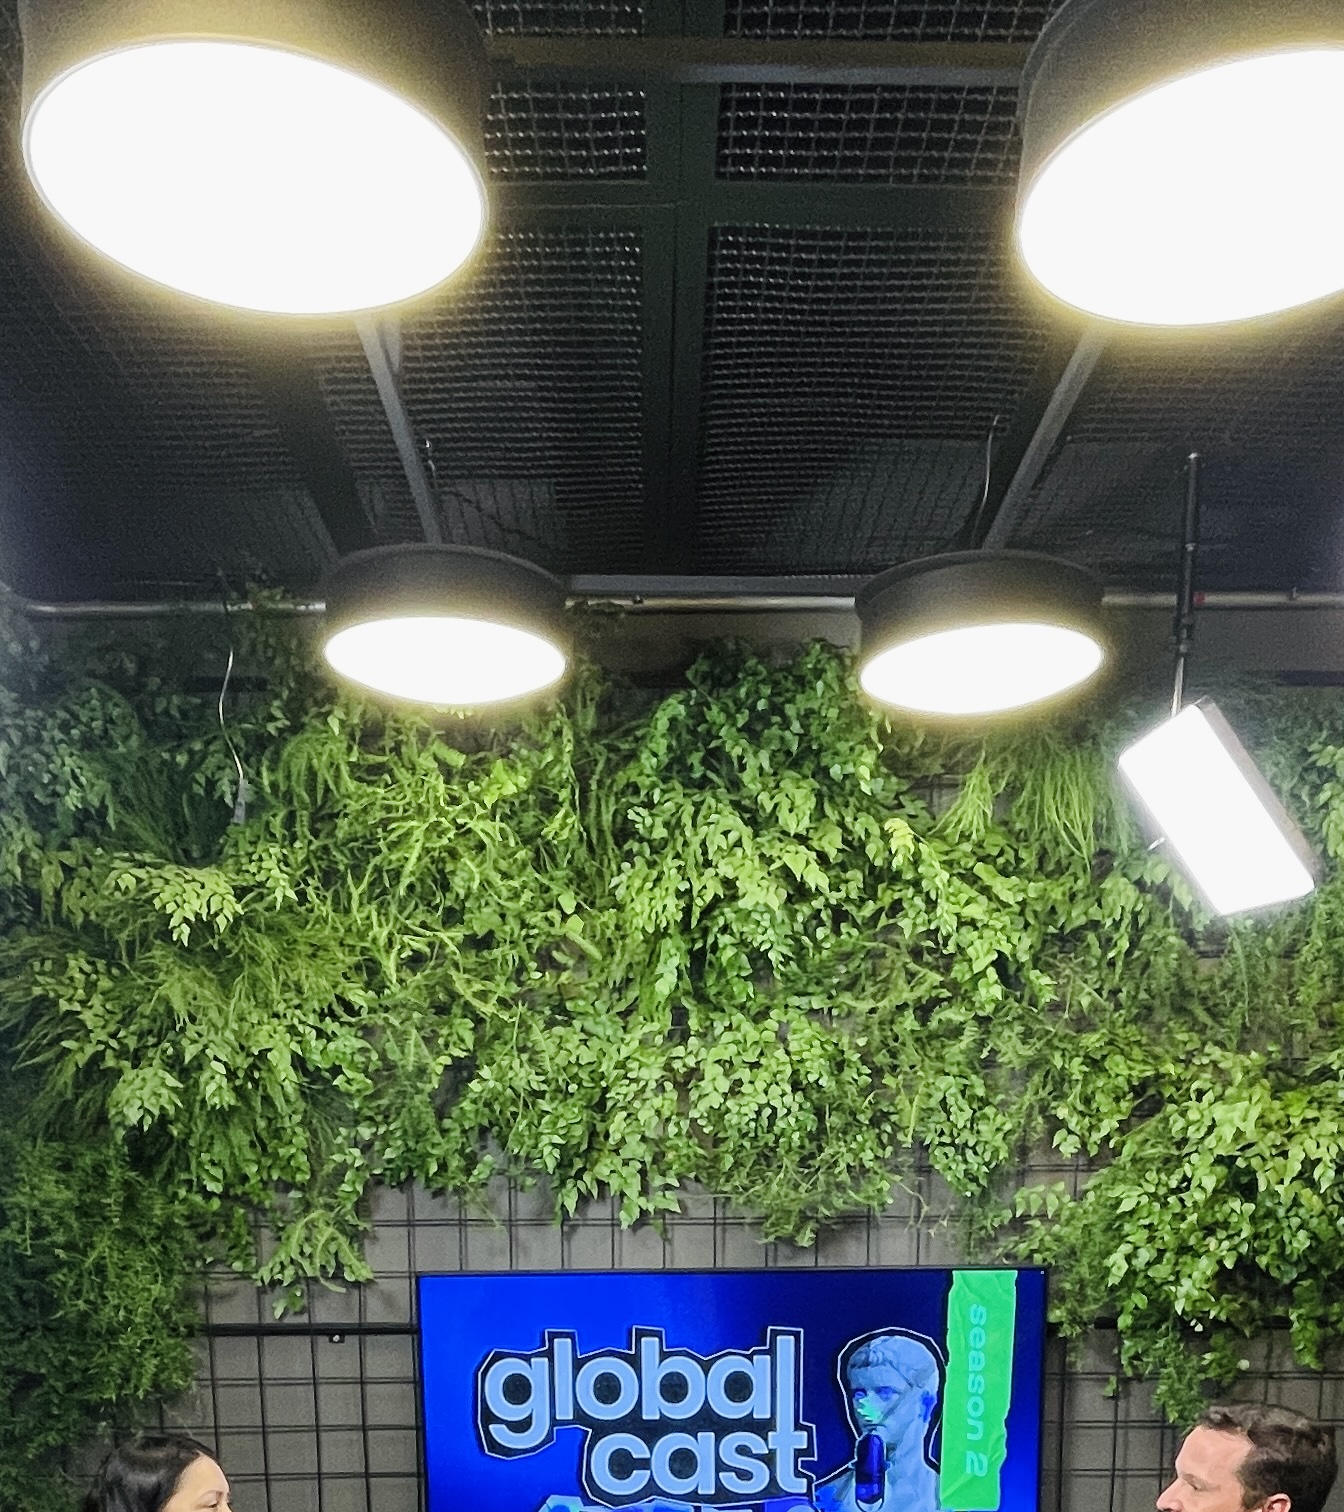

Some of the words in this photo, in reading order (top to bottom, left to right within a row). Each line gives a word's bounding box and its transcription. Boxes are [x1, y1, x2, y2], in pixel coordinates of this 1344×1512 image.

[483, 1335, 795, 1450] global
[966, 1303, 988, 1441] season
[590, 1423, 809, 1495] cast
[966, 1450, 989, 1477] 2
